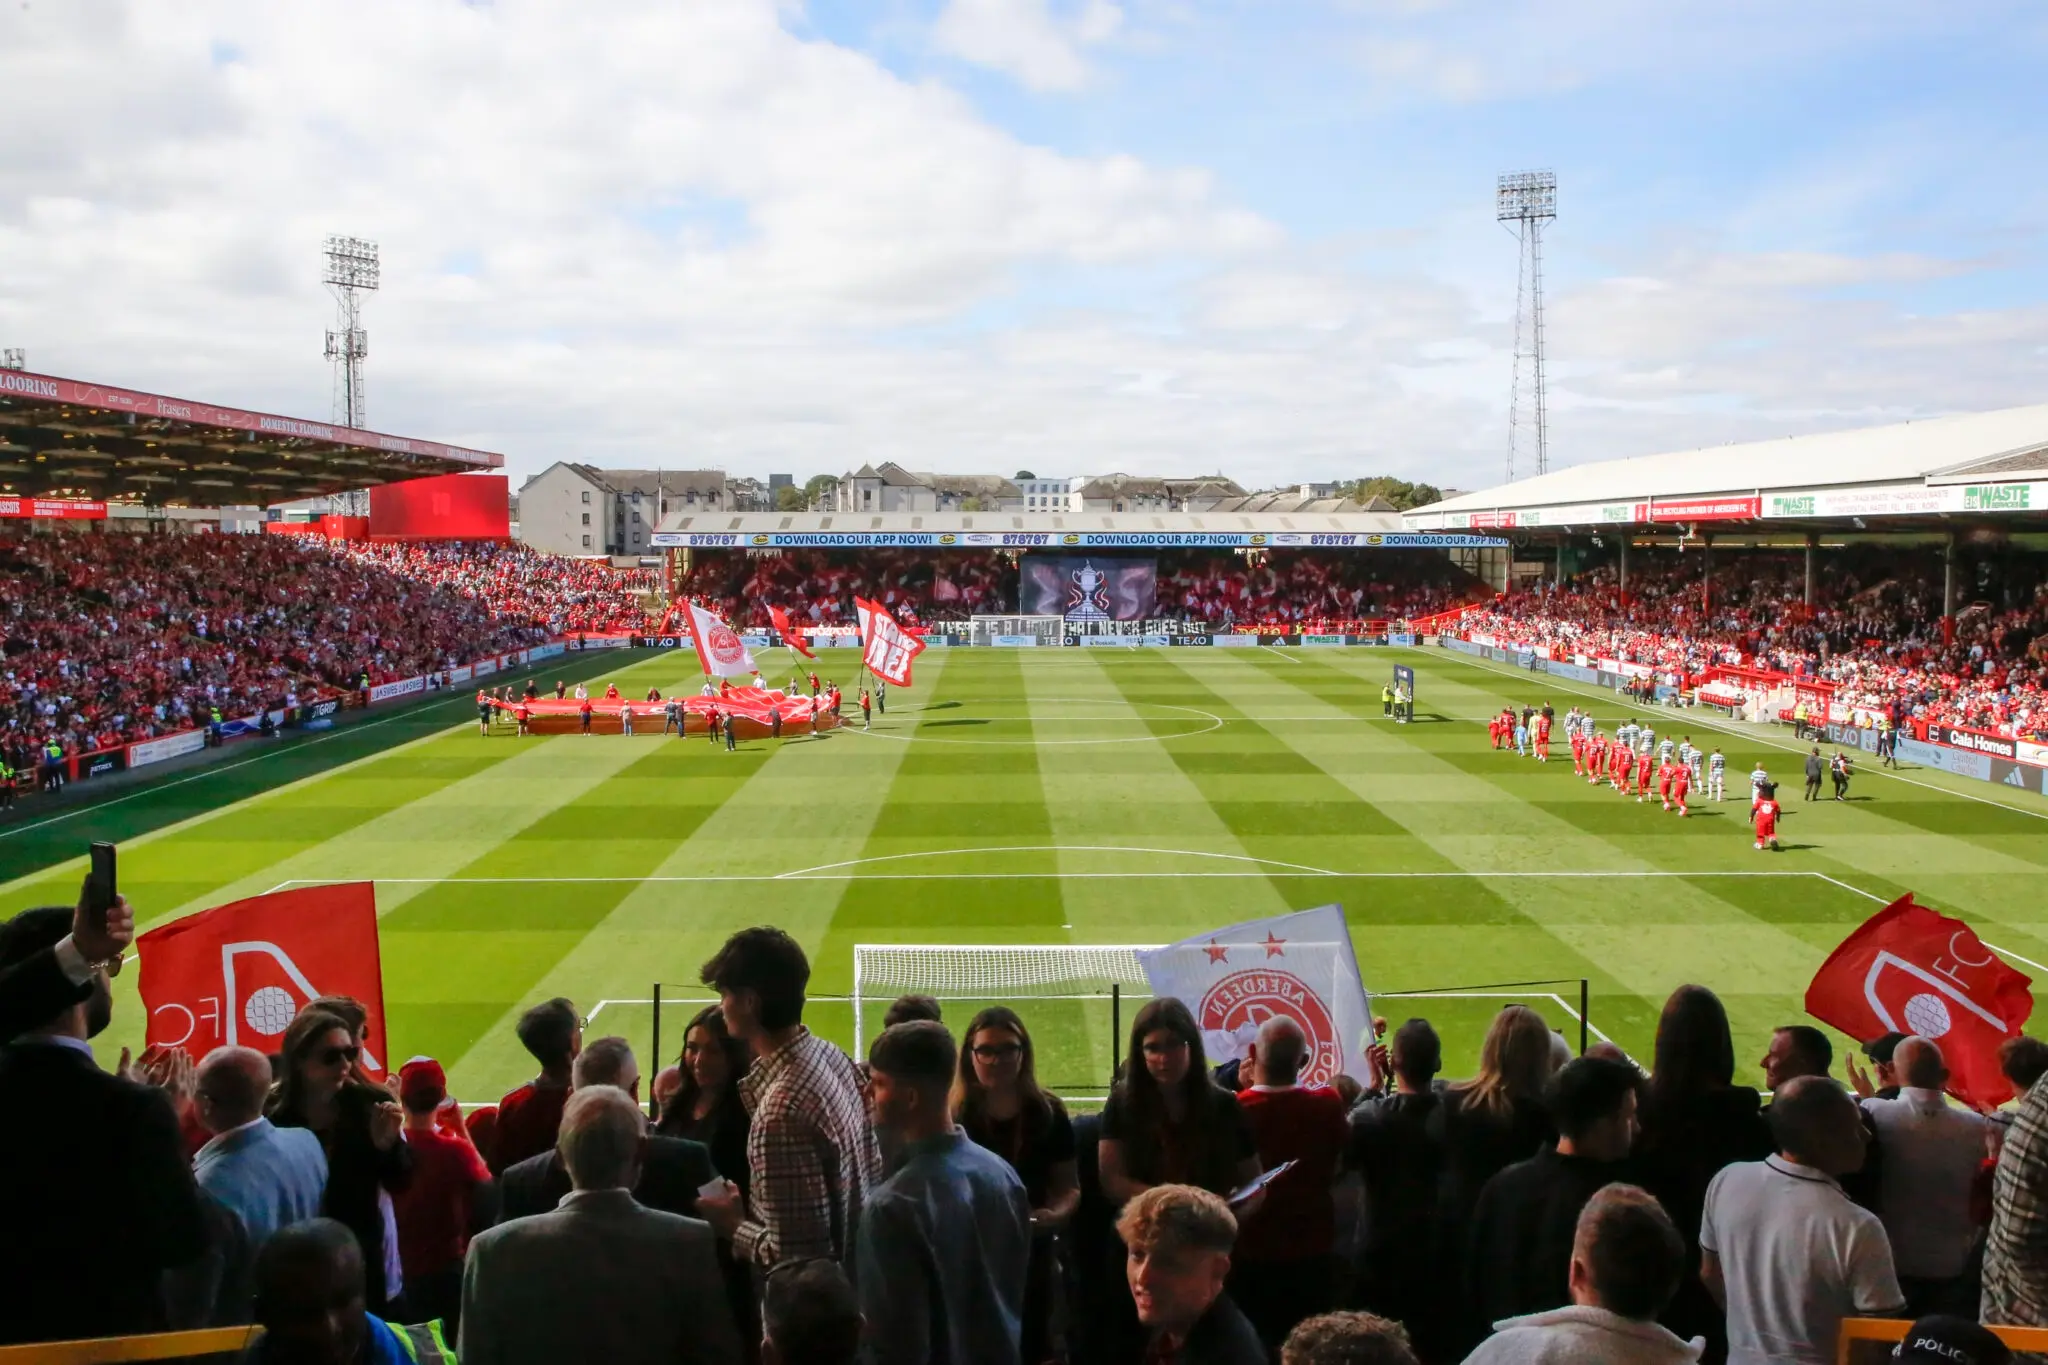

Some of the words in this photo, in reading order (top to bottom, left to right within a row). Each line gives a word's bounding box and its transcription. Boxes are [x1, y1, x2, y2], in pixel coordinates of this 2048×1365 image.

[157, 399, 191, 418] Frasers
[260, 417, 297, 433] DOMESTIC
[299, 423, 333, 438] FLOORING
[1978, 485, 2030, 509] WASTE
[1714, 503, 1739, 512] ABERDEEN
[1783, 497, 1815, 515] WASTE
[690, 535, 737, 545] 878787
[775, 535, 844, 545] DOWNLOAD
[846, 535, 872, 545] OUR
[873, 535, 896, 545] APP
[899, 535, 932, 545] NOW!
[1002, 535, 1049, 545] 878787
[1087, 535, 1155, 545] DOWNLOAD
[1158, 535, 1182, 545] OUR
[1184, 535, 1206, 545] APP
[1209, 535, 1242, 545] NOW!
[1310, 535, 1357, 545] 878787
[1386, 536, 1443, 545] DOWNLOAD
[1449, 536, 1466, 545] OUR
[1468, 536, 1486, 545] APP
[985, 621, 998, 636] IS
[1003, 621, 1013, 636] A
[1099, 620, 1140, 636] NEVER
[1145, 620, 1178, 636] GOES
[1182, 621, 1207, 635] OUT
[1176, 636, 1207, 646] TEXO
[1828, 724, 1859, 746] TEXO
[1950, 730, 1974, 748] Cala
[1974, 735, 2012, 756] Homes
[1932, 929, 1993, 990] FC
[1914, 1337, 1975, 1364] POLIC
